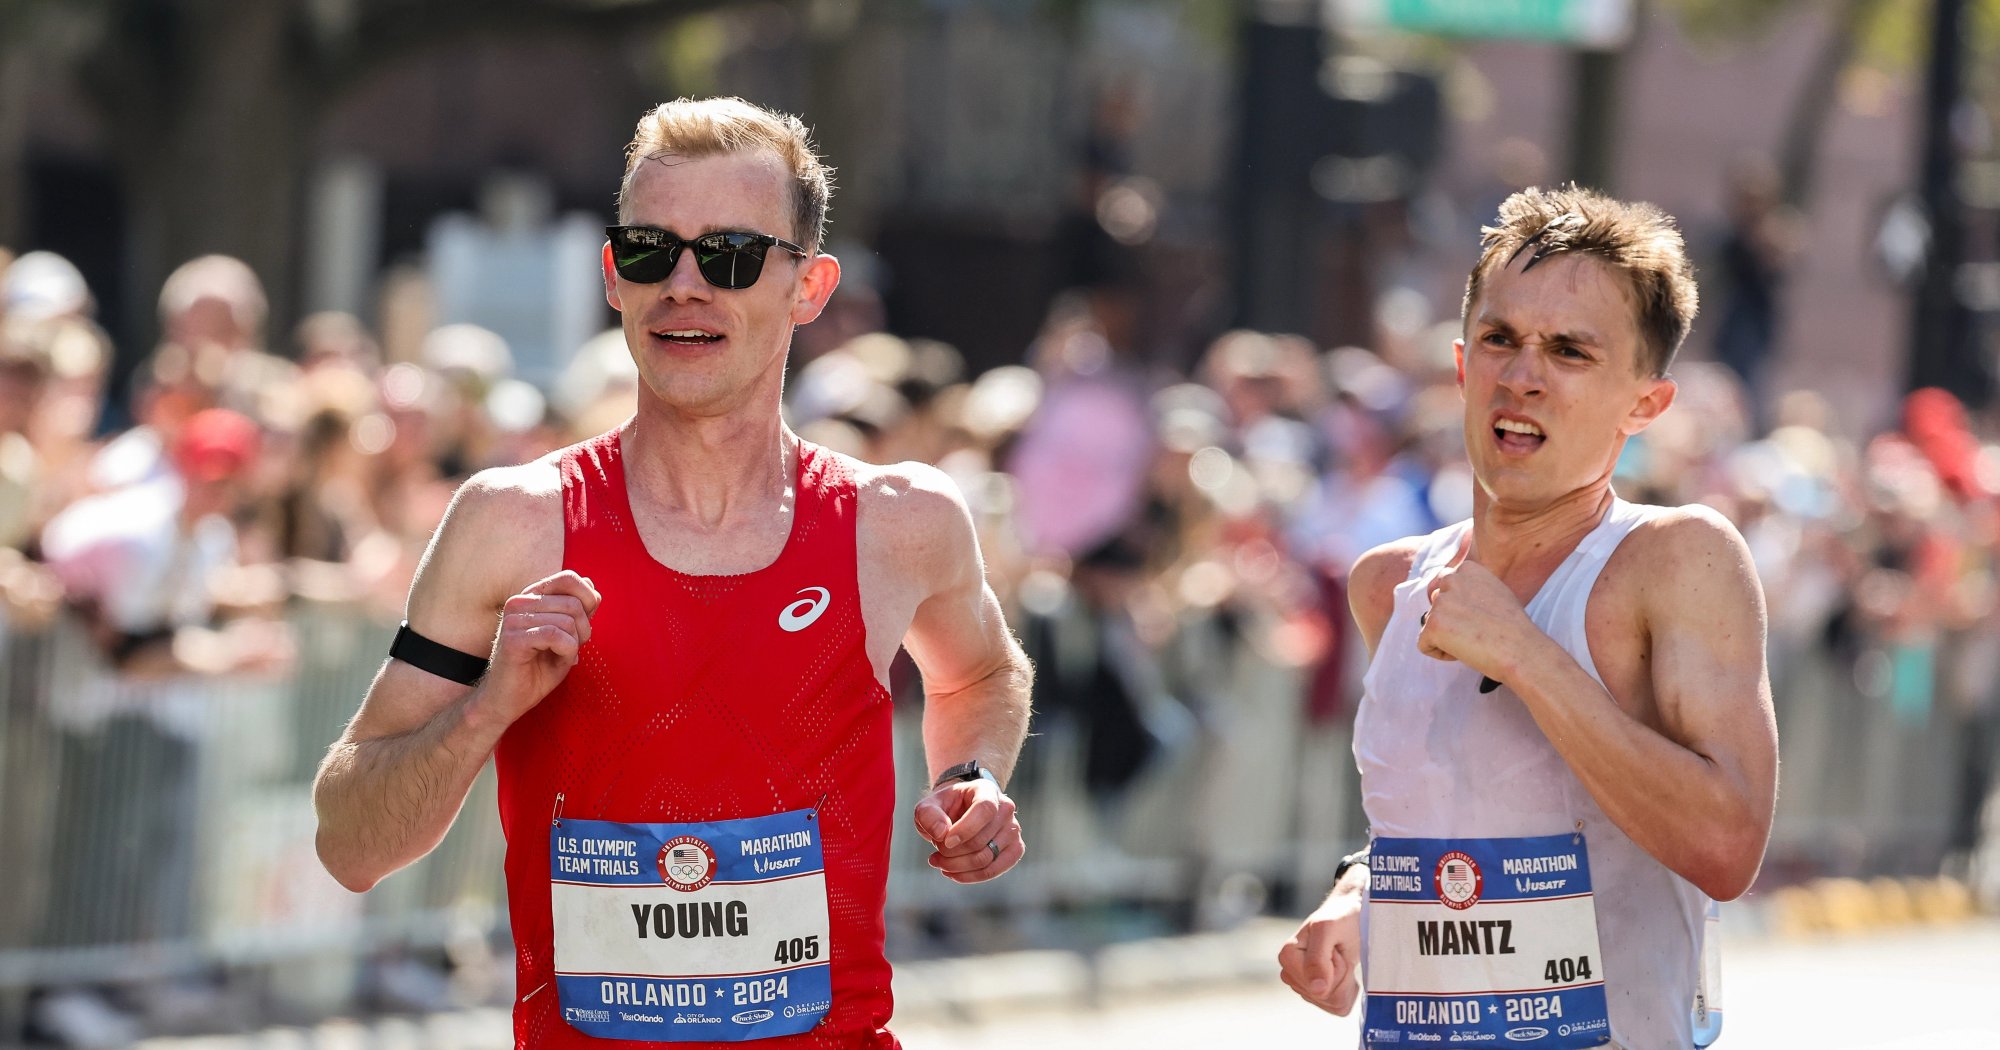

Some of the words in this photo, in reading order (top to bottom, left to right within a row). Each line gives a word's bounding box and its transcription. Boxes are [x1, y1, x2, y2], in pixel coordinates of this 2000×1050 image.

[558, 837, 580, 854] U.S.
[582, 839, 637, 857] OLYMPIC
[661, 837, 684, 853] UNITED
[686, 837, 709, 852] STATES
[741, 830, 811, 856] MARATHON
[558, 856, 590, 874] TEAM
[593, 859, 639, 875] TRIALS
[769, 857, 801, 871] USATF
[1372, 855, 1387, 871] U.S.
[1387, 856, 1420, 872] OLYMPIC
[1503, 853, 1578, 875] MARATHON
[664, 876, 692, 891] OLYMPIC
[694, 875, 711, 889] TEAM
[1372, 875, 1393, 891] TEAM
[1393, 875, 1422, 892] TRIALS
[1531, 879, 1567, 891] USATF
[631, 900, 749, 939] YOUNG
[1417, 920, 1516, 956] MANTZ
[774, 935, 819, 964] 405
[1544, 956, 1592, 983] 404
[601, 981, 706, 1007] ORLANDO
[733, 976, 789, 1006] 2024
[796, 1004, 830, 1013] ORLANDO
[1396, 1000, 1480, 1025] ORLANDO
[1505, 995, 1563, 1022] 2024
[1572, 1022, 1607, 1032] ORLANDO
